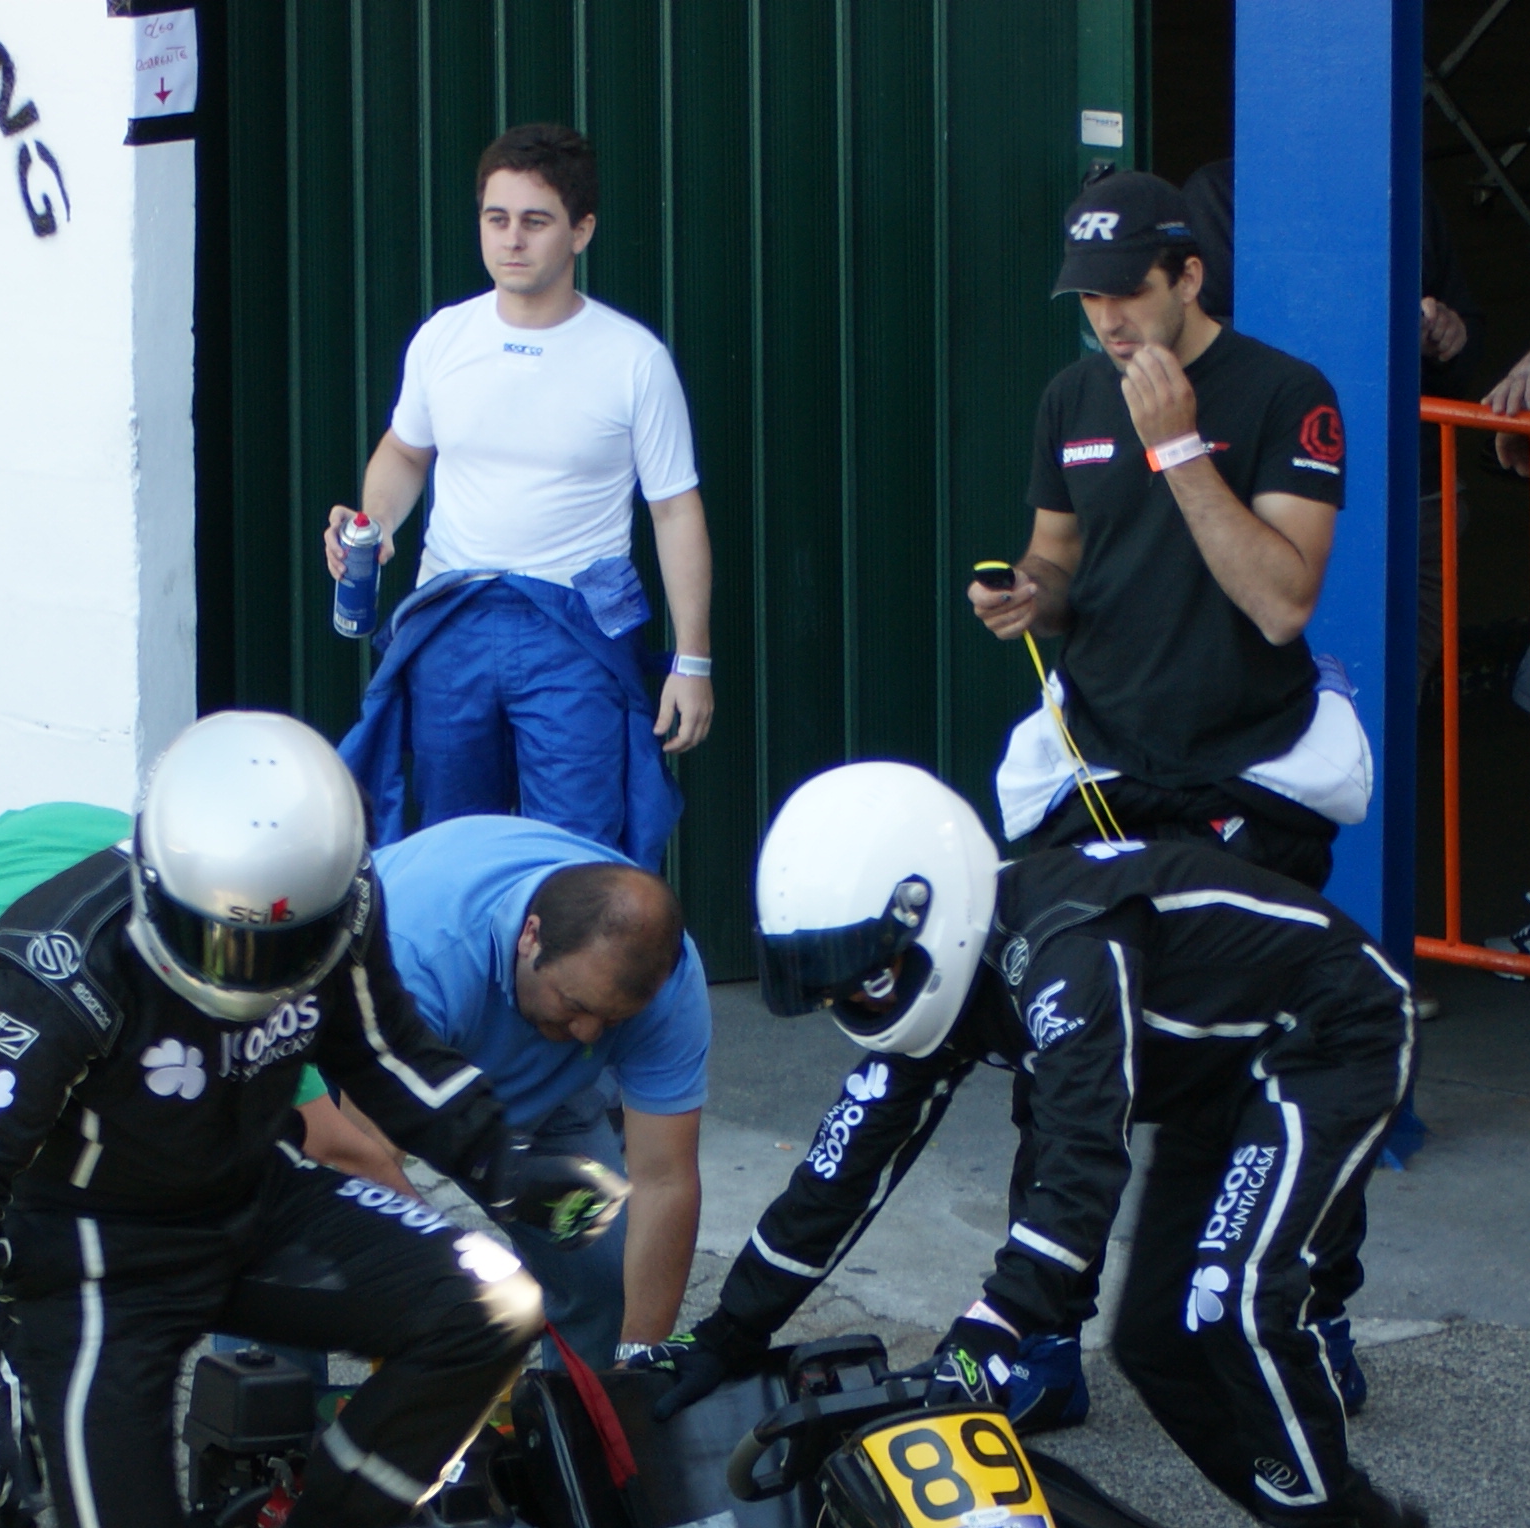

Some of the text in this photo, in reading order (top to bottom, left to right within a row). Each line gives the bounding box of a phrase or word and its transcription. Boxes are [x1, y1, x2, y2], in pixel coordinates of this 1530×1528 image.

[1198, 1145, 1257, 1251] JOGOS
[1225, 1146, 1278, 1241] SANTACASA
[888, 1418, 1032, 1522] 89
